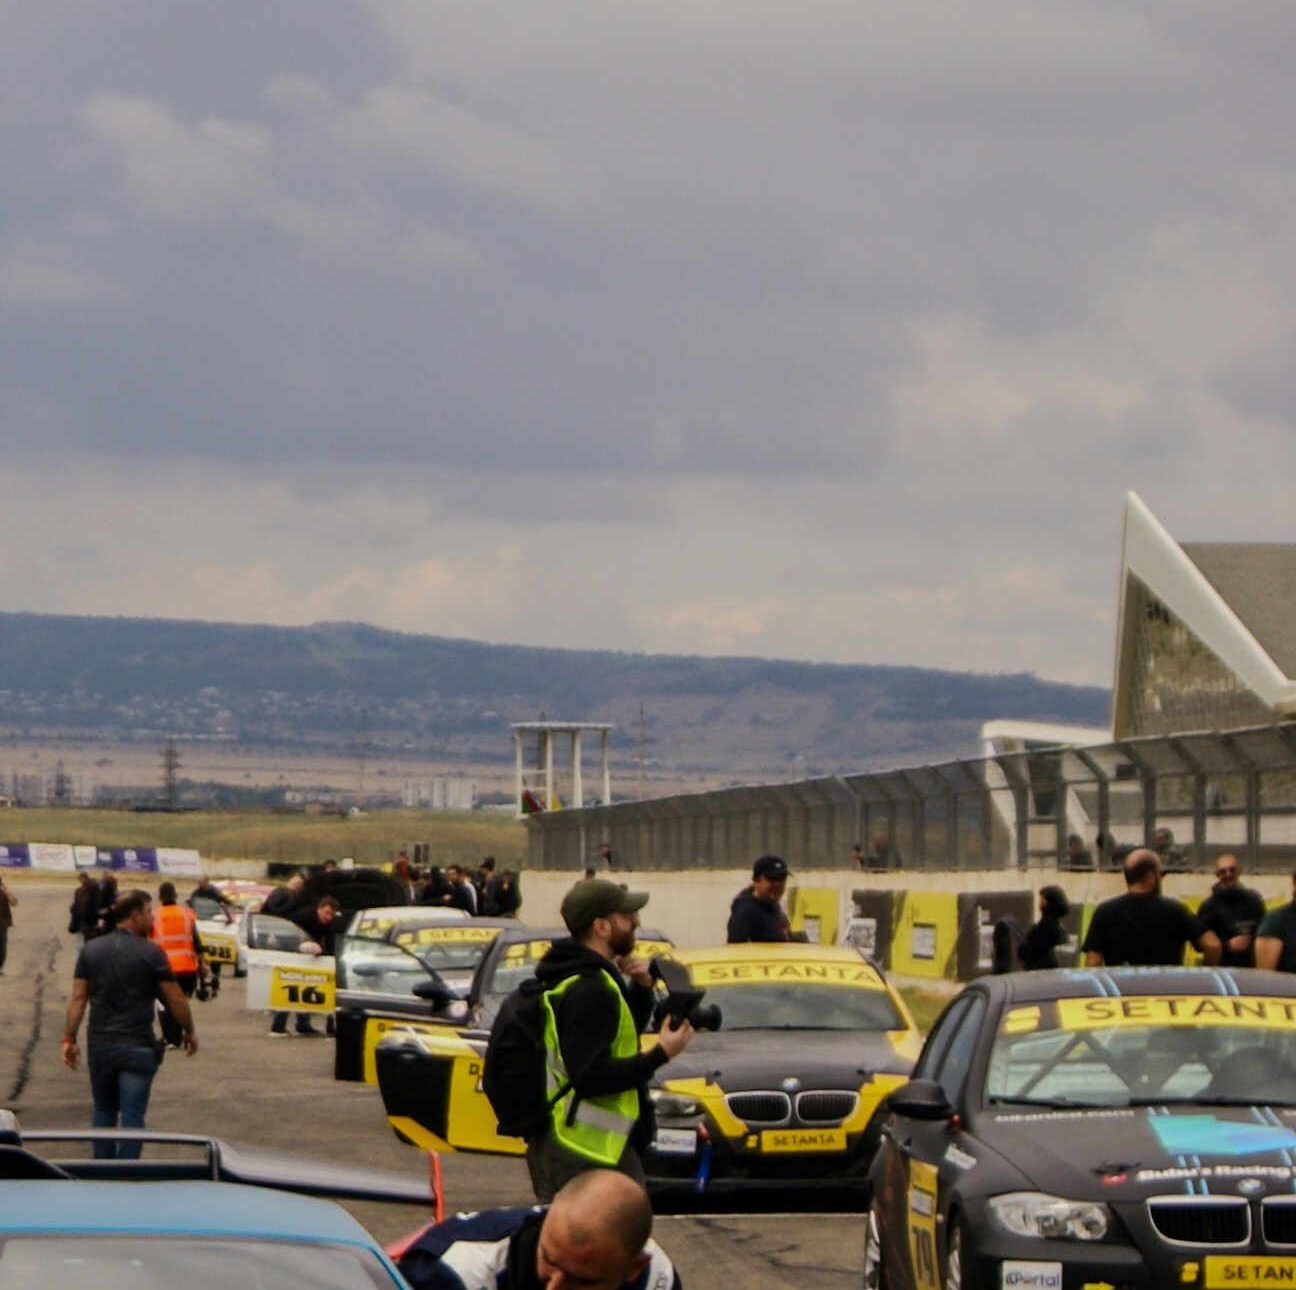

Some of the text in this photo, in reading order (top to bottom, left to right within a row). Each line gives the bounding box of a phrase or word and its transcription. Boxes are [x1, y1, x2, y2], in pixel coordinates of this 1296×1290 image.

[709, 964, 877, 982] SETANTA
[281, 985, 326, 1005] 16
[772, 1133, 836, 1145] SETANTA
[1214, 1164, 1291, 1180] Racing
